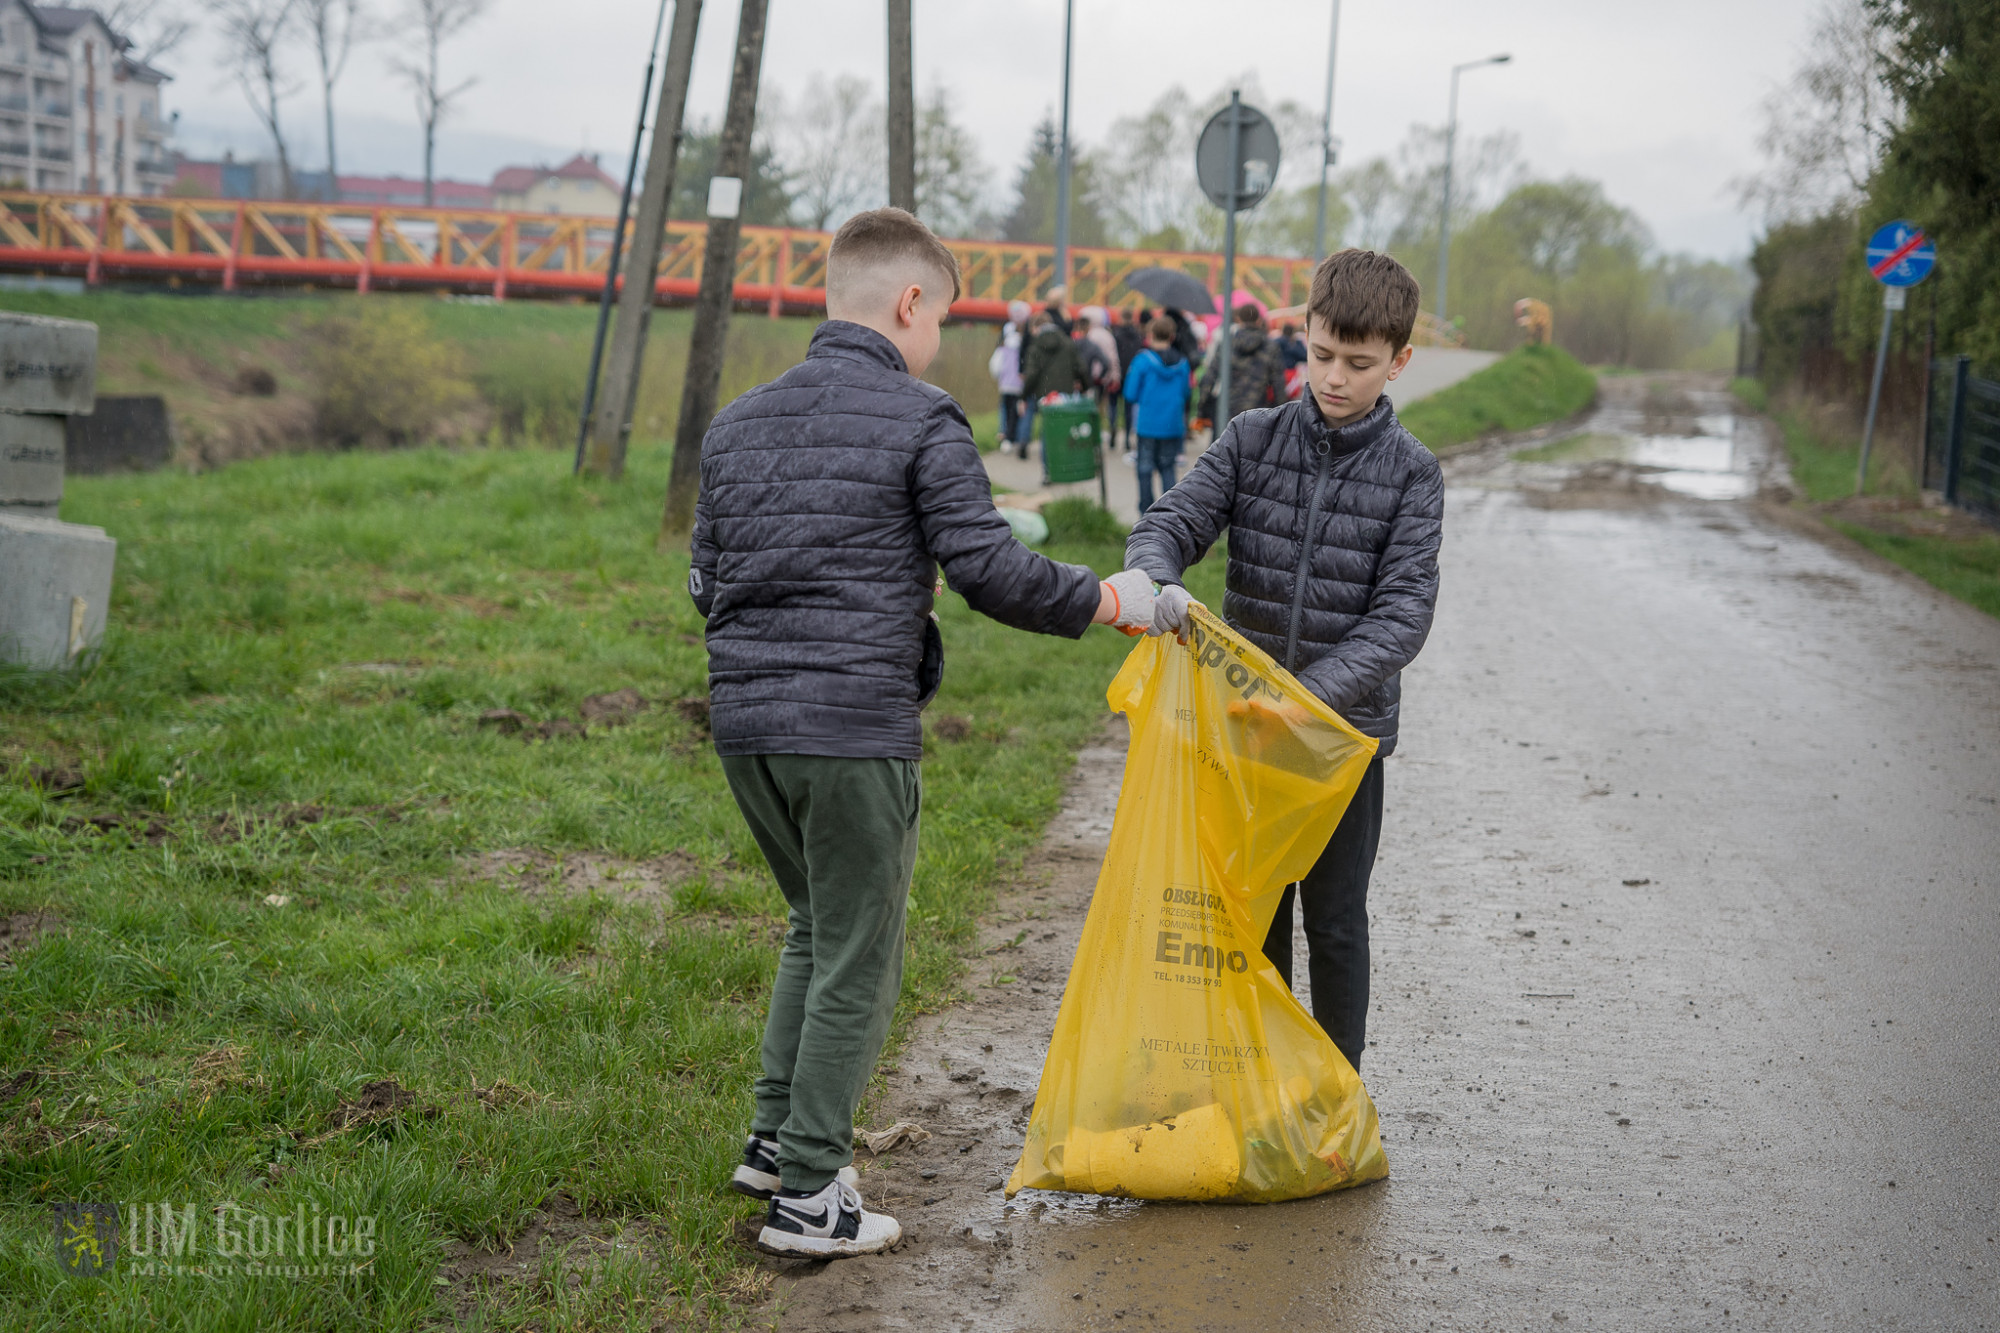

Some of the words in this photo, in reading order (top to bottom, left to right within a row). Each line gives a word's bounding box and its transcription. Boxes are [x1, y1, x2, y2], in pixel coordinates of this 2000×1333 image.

[1153, 971, 1172, 982] TEL.
[1175, 974, 1185, 983] 18
[1186, 975, 1201, 985] 353
[1203, 977, 1212, 987] 97
[1139, 1037, 1201, 1056] METALE
[1204, 1044, 1209, 1057] I
